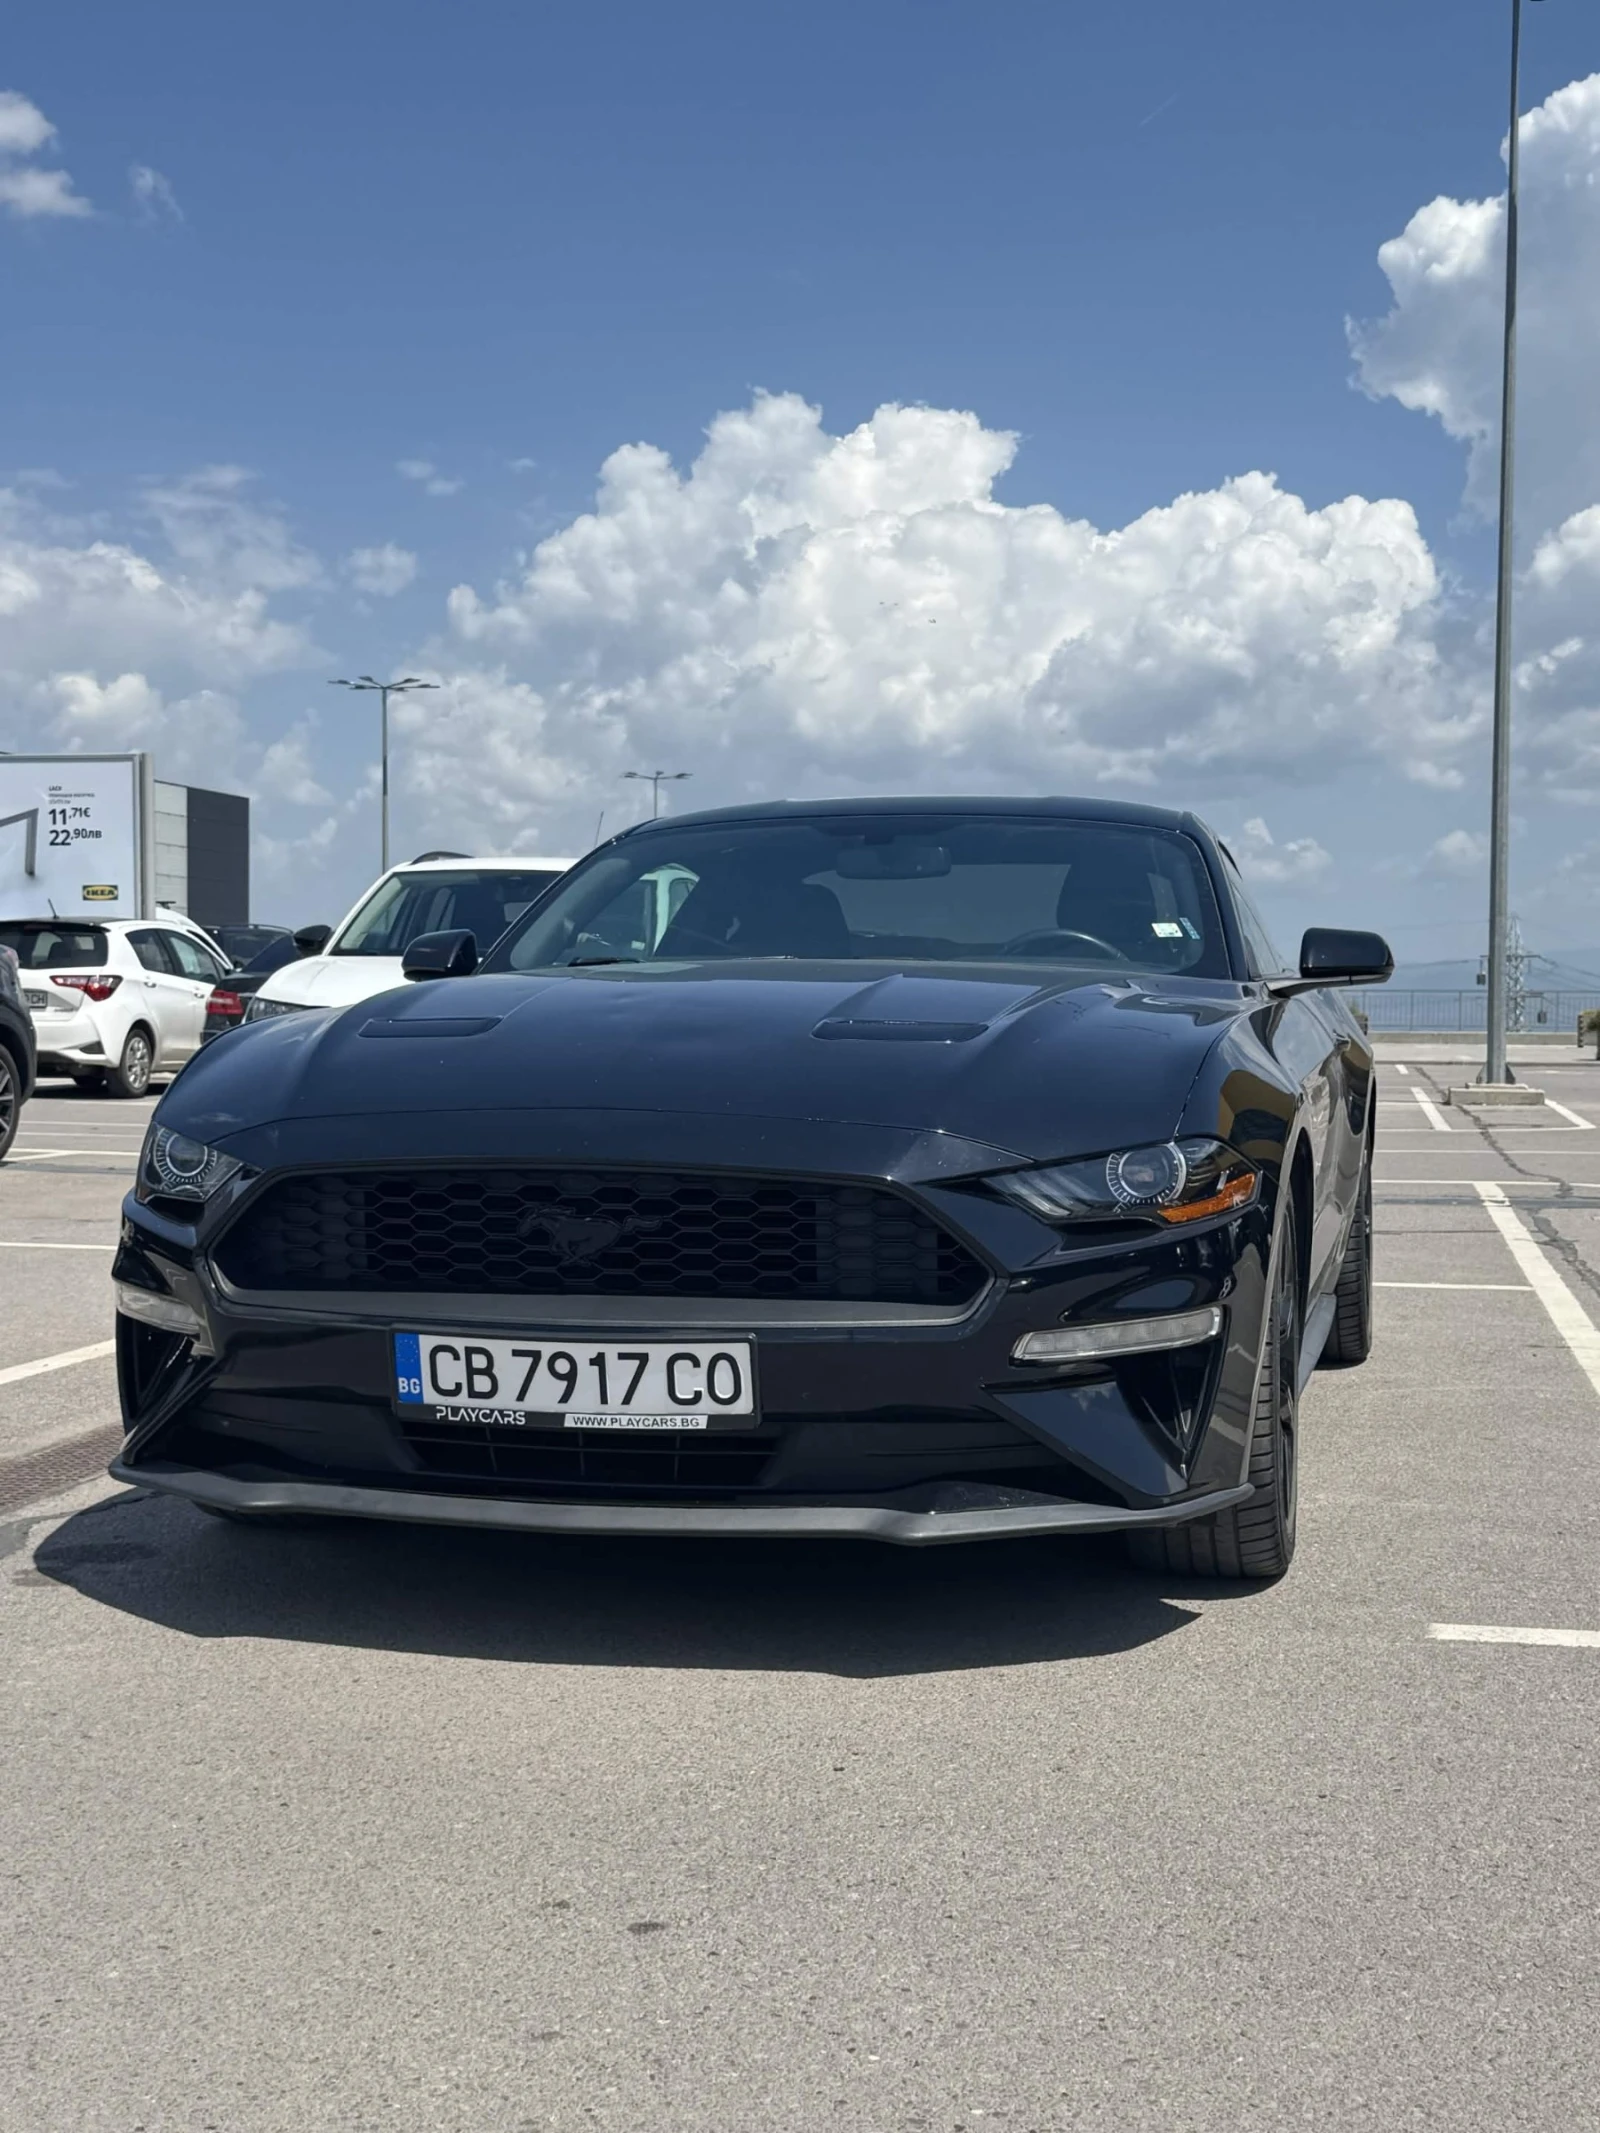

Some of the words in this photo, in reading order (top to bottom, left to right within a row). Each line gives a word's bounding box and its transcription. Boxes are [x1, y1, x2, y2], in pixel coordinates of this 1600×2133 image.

[48, 807, 91, 825] 11,71€
[429, 1344, 498, 1399] CB
[511, 1349, 649, 1405] 7917
[666, 1352, 742, 1406] CO
[398, 1377, 420, 1394] BG
[436, 1406, 526, 1425] PLAYCARS
[573, 1416, 700, 1428] WWW.PLAYCARS.BG
